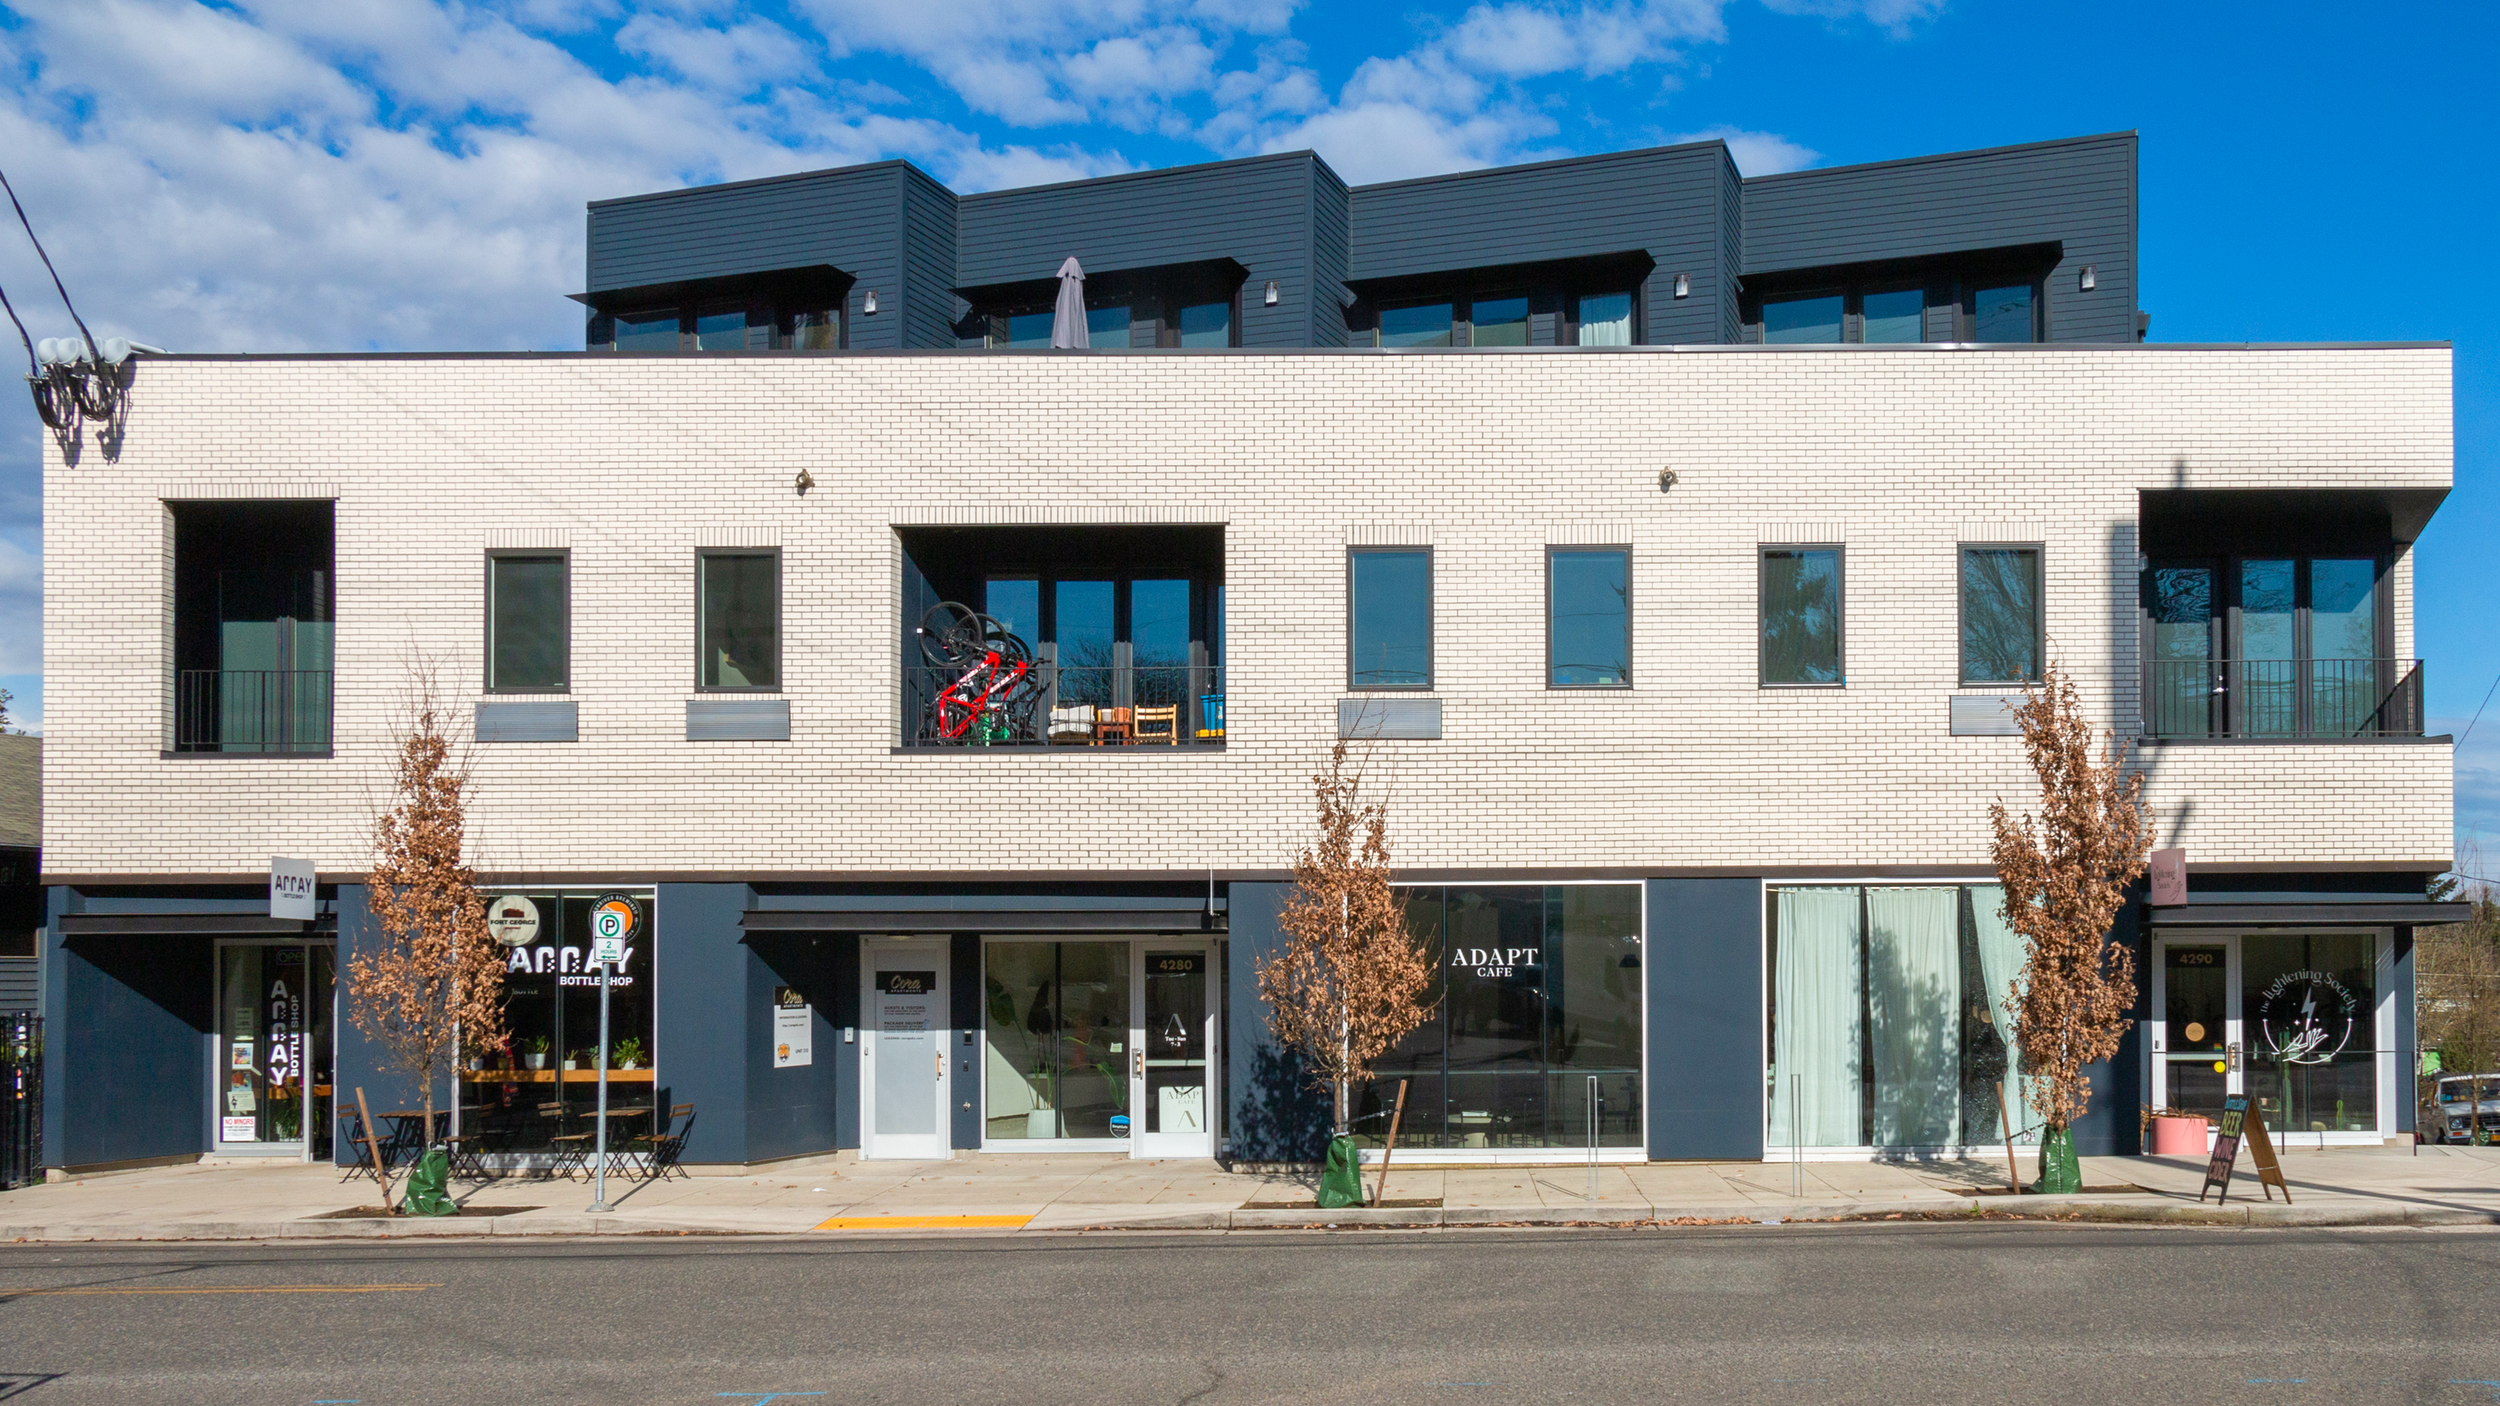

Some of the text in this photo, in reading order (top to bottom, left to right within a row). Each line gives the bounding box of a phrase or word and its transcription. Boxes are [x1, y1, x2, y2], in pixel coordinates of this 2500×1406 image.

[605, 919, 616, 933] P
[606, 941, 612, 949] 2
[1451, 948, 1539, 966] ADAPT
[2180, 954, 2213, 964] 4290
[1160, 960, 1192, 970] 4280
[1476, 967, 1513, 977] CAFE
[560, 975, 634, 987] BOTTLE HOP
[891, 975, 921, 989] Cora
[783, 989, 803, 1004] Cora
[290, 995, 299, 1077] BOTTLE SHOP
[1166, 1090, 1202, 1100] ADAP
[2219, 1110, 2243, 1137] BEER
[2214, 1137, 2237, 1160] WINE
[2208, 1160, 2230, 1183] CIDER
